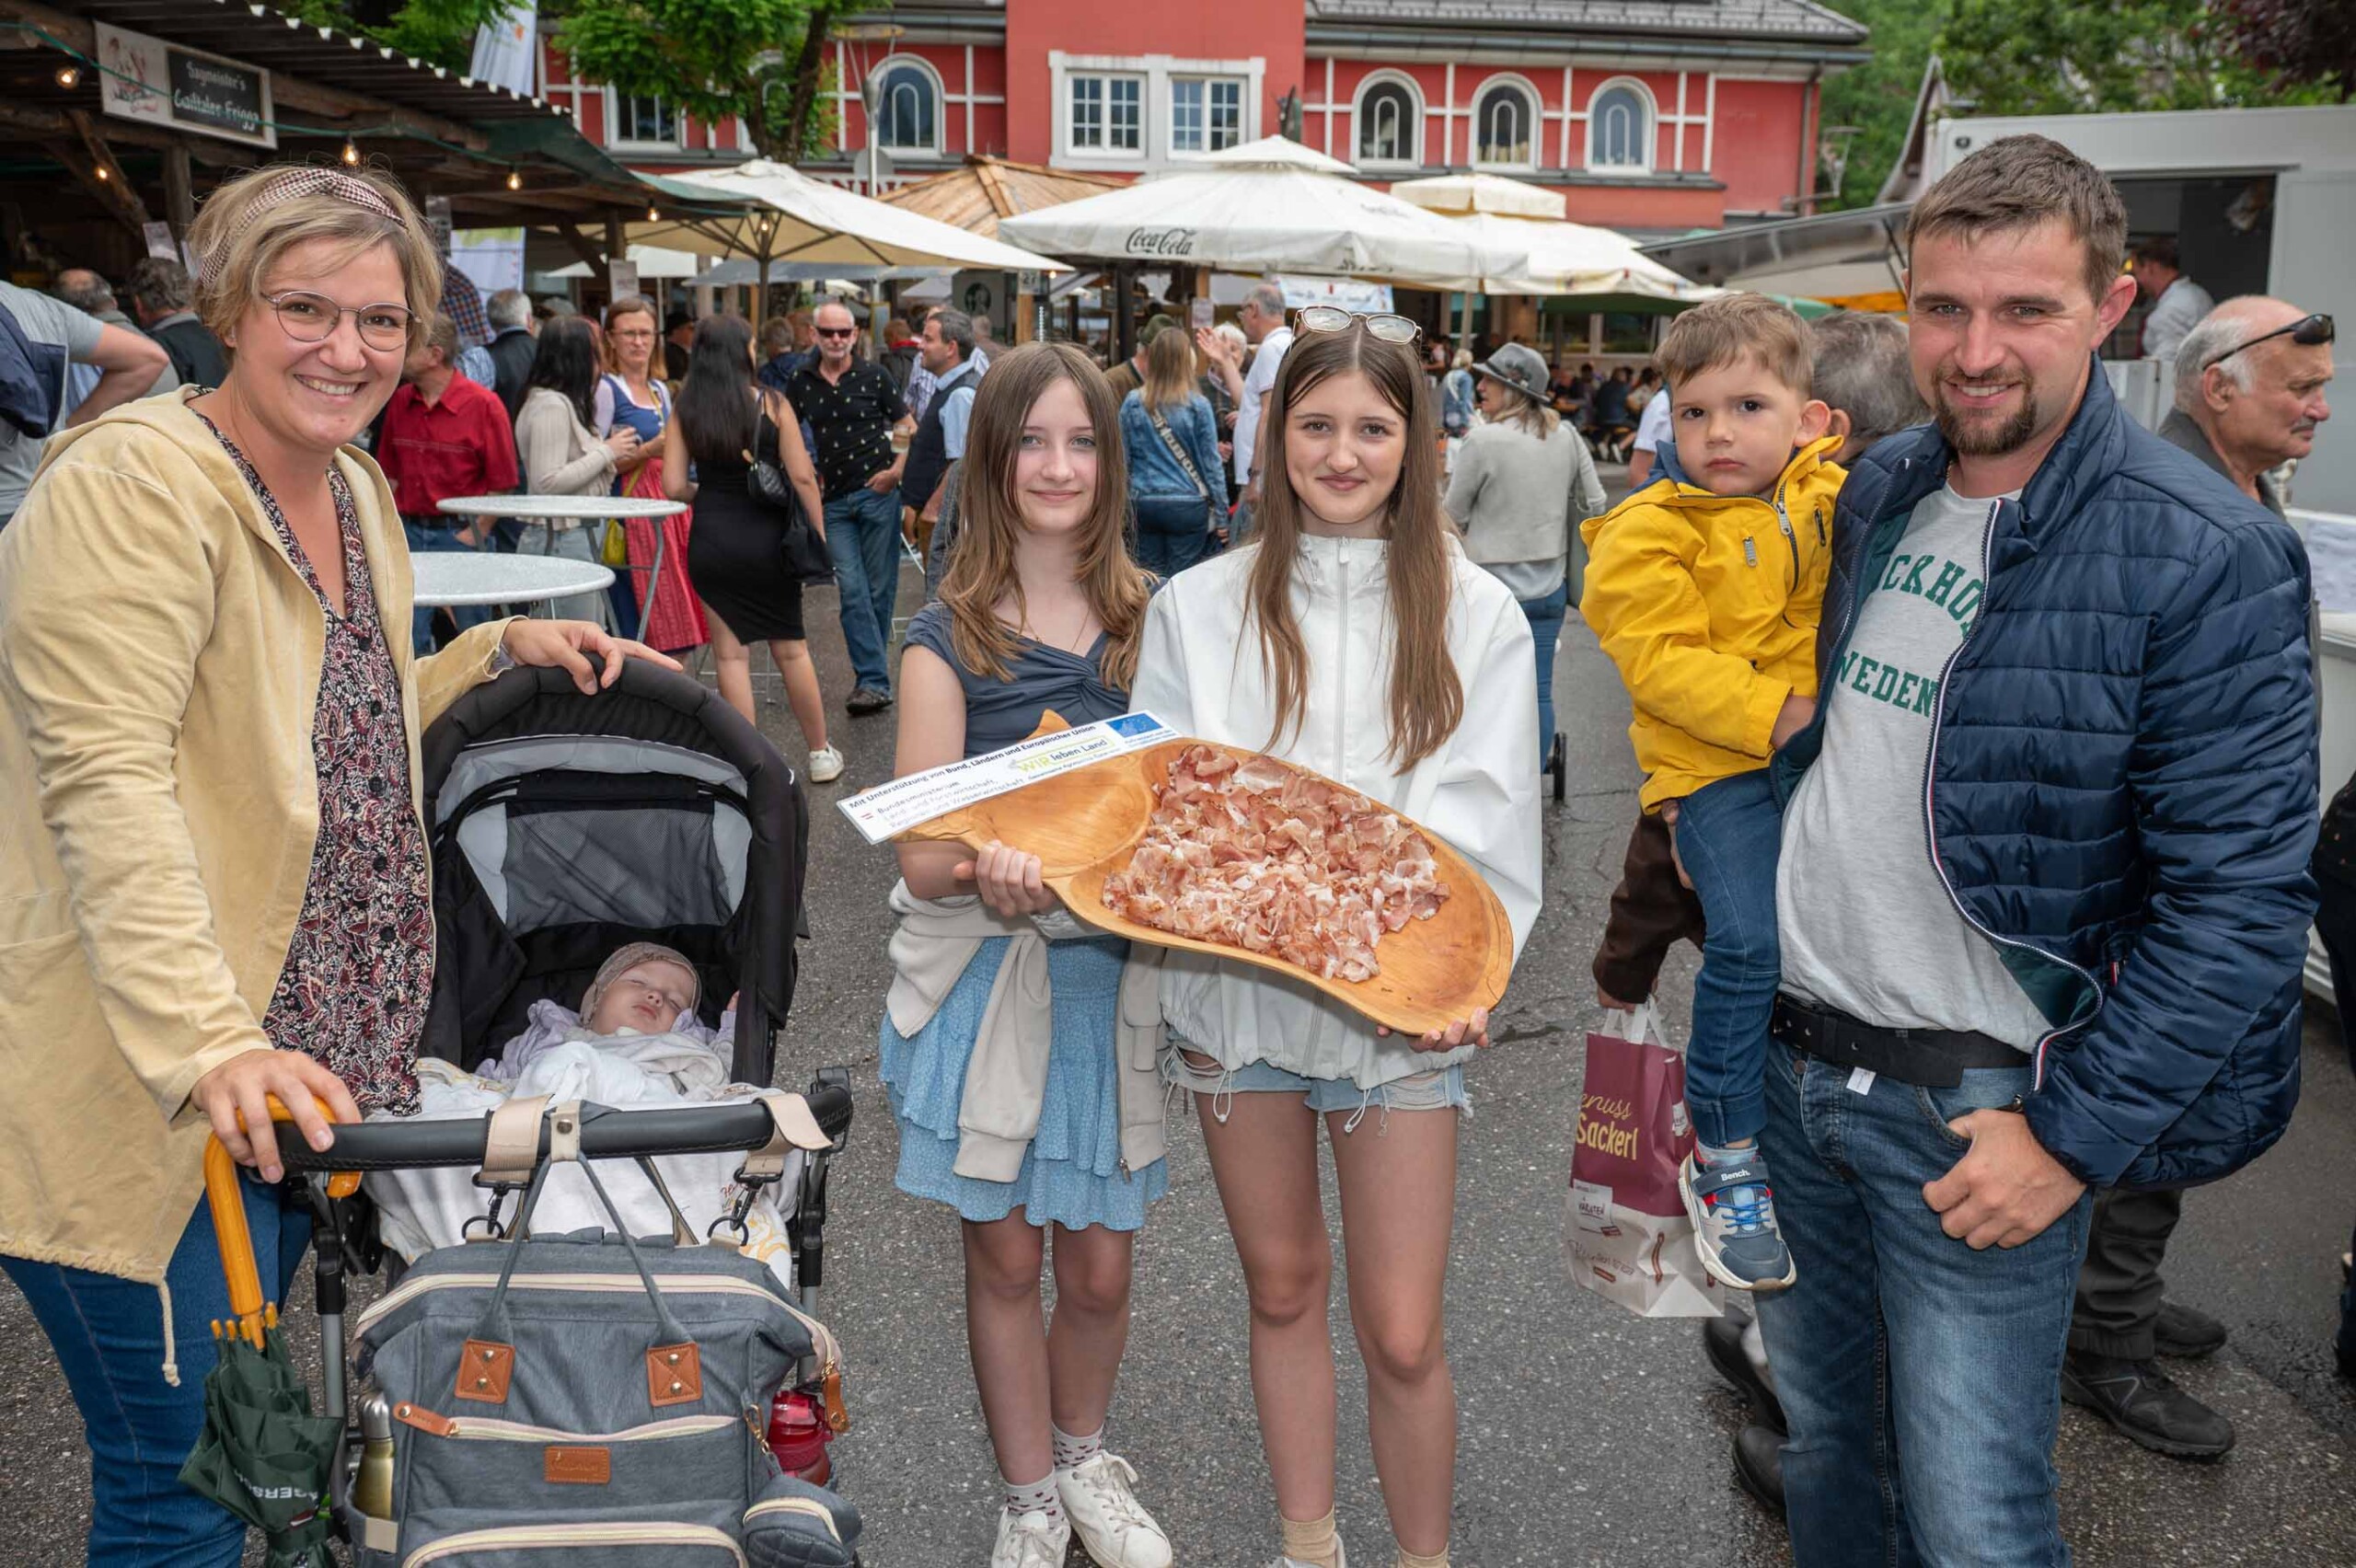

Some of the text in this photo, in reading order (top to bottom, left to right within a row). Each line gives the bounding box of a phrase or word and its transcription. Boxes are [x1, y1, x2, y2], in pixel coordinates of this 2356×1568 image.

[849, 725, 1096, 809] Mit Unterstützung von Bund, Ländern und Europäischer Union
[1050, 747, 1081, 761] leben
[1080, 739, 1108, 752] Land
[1575, 1112, 1638, 1160] Sackerl
